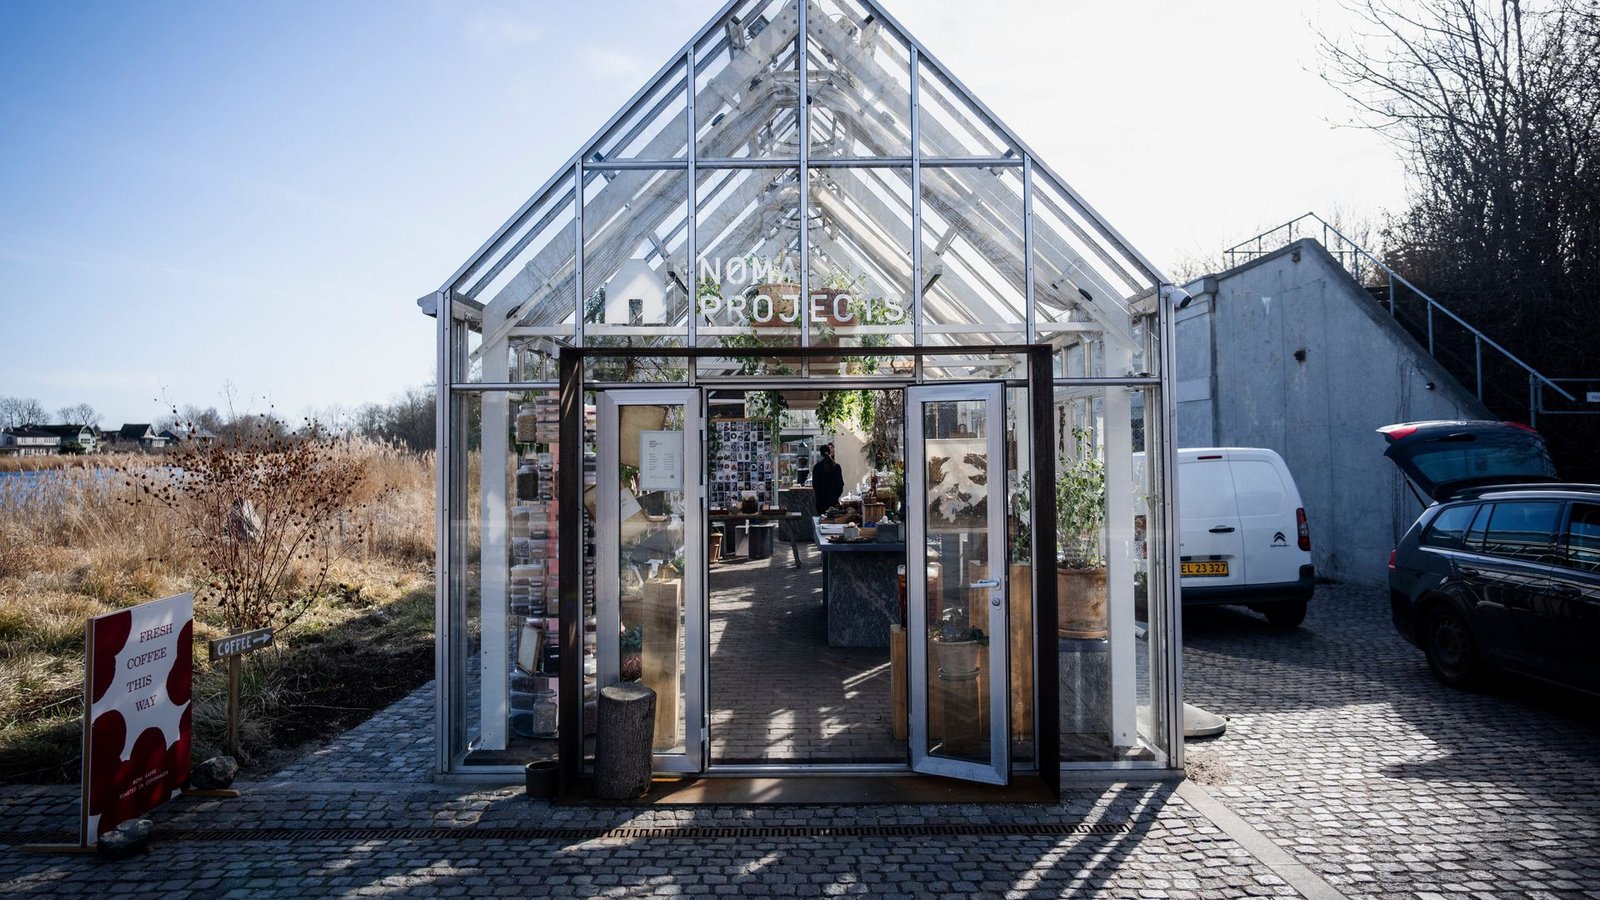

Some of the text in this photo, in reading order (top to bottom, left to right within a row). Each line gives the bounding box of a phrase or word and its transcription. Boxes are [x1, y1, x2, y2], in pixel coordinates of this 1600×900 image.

[700, 256, 799, 285] NOMA
[700, 293, 904, 323] PROJECTS
[1195, 564, 1207, 573] 23
[1209, 563, 1226, 573] 327
[140, 623, 173, 643] FRESH
[217, 635, 252, 656] COFFEE
[127, 647, 167, 670] COFFEE
[126, 674, 152, 693] THIS
[135, 695, 157, 712] WAY
